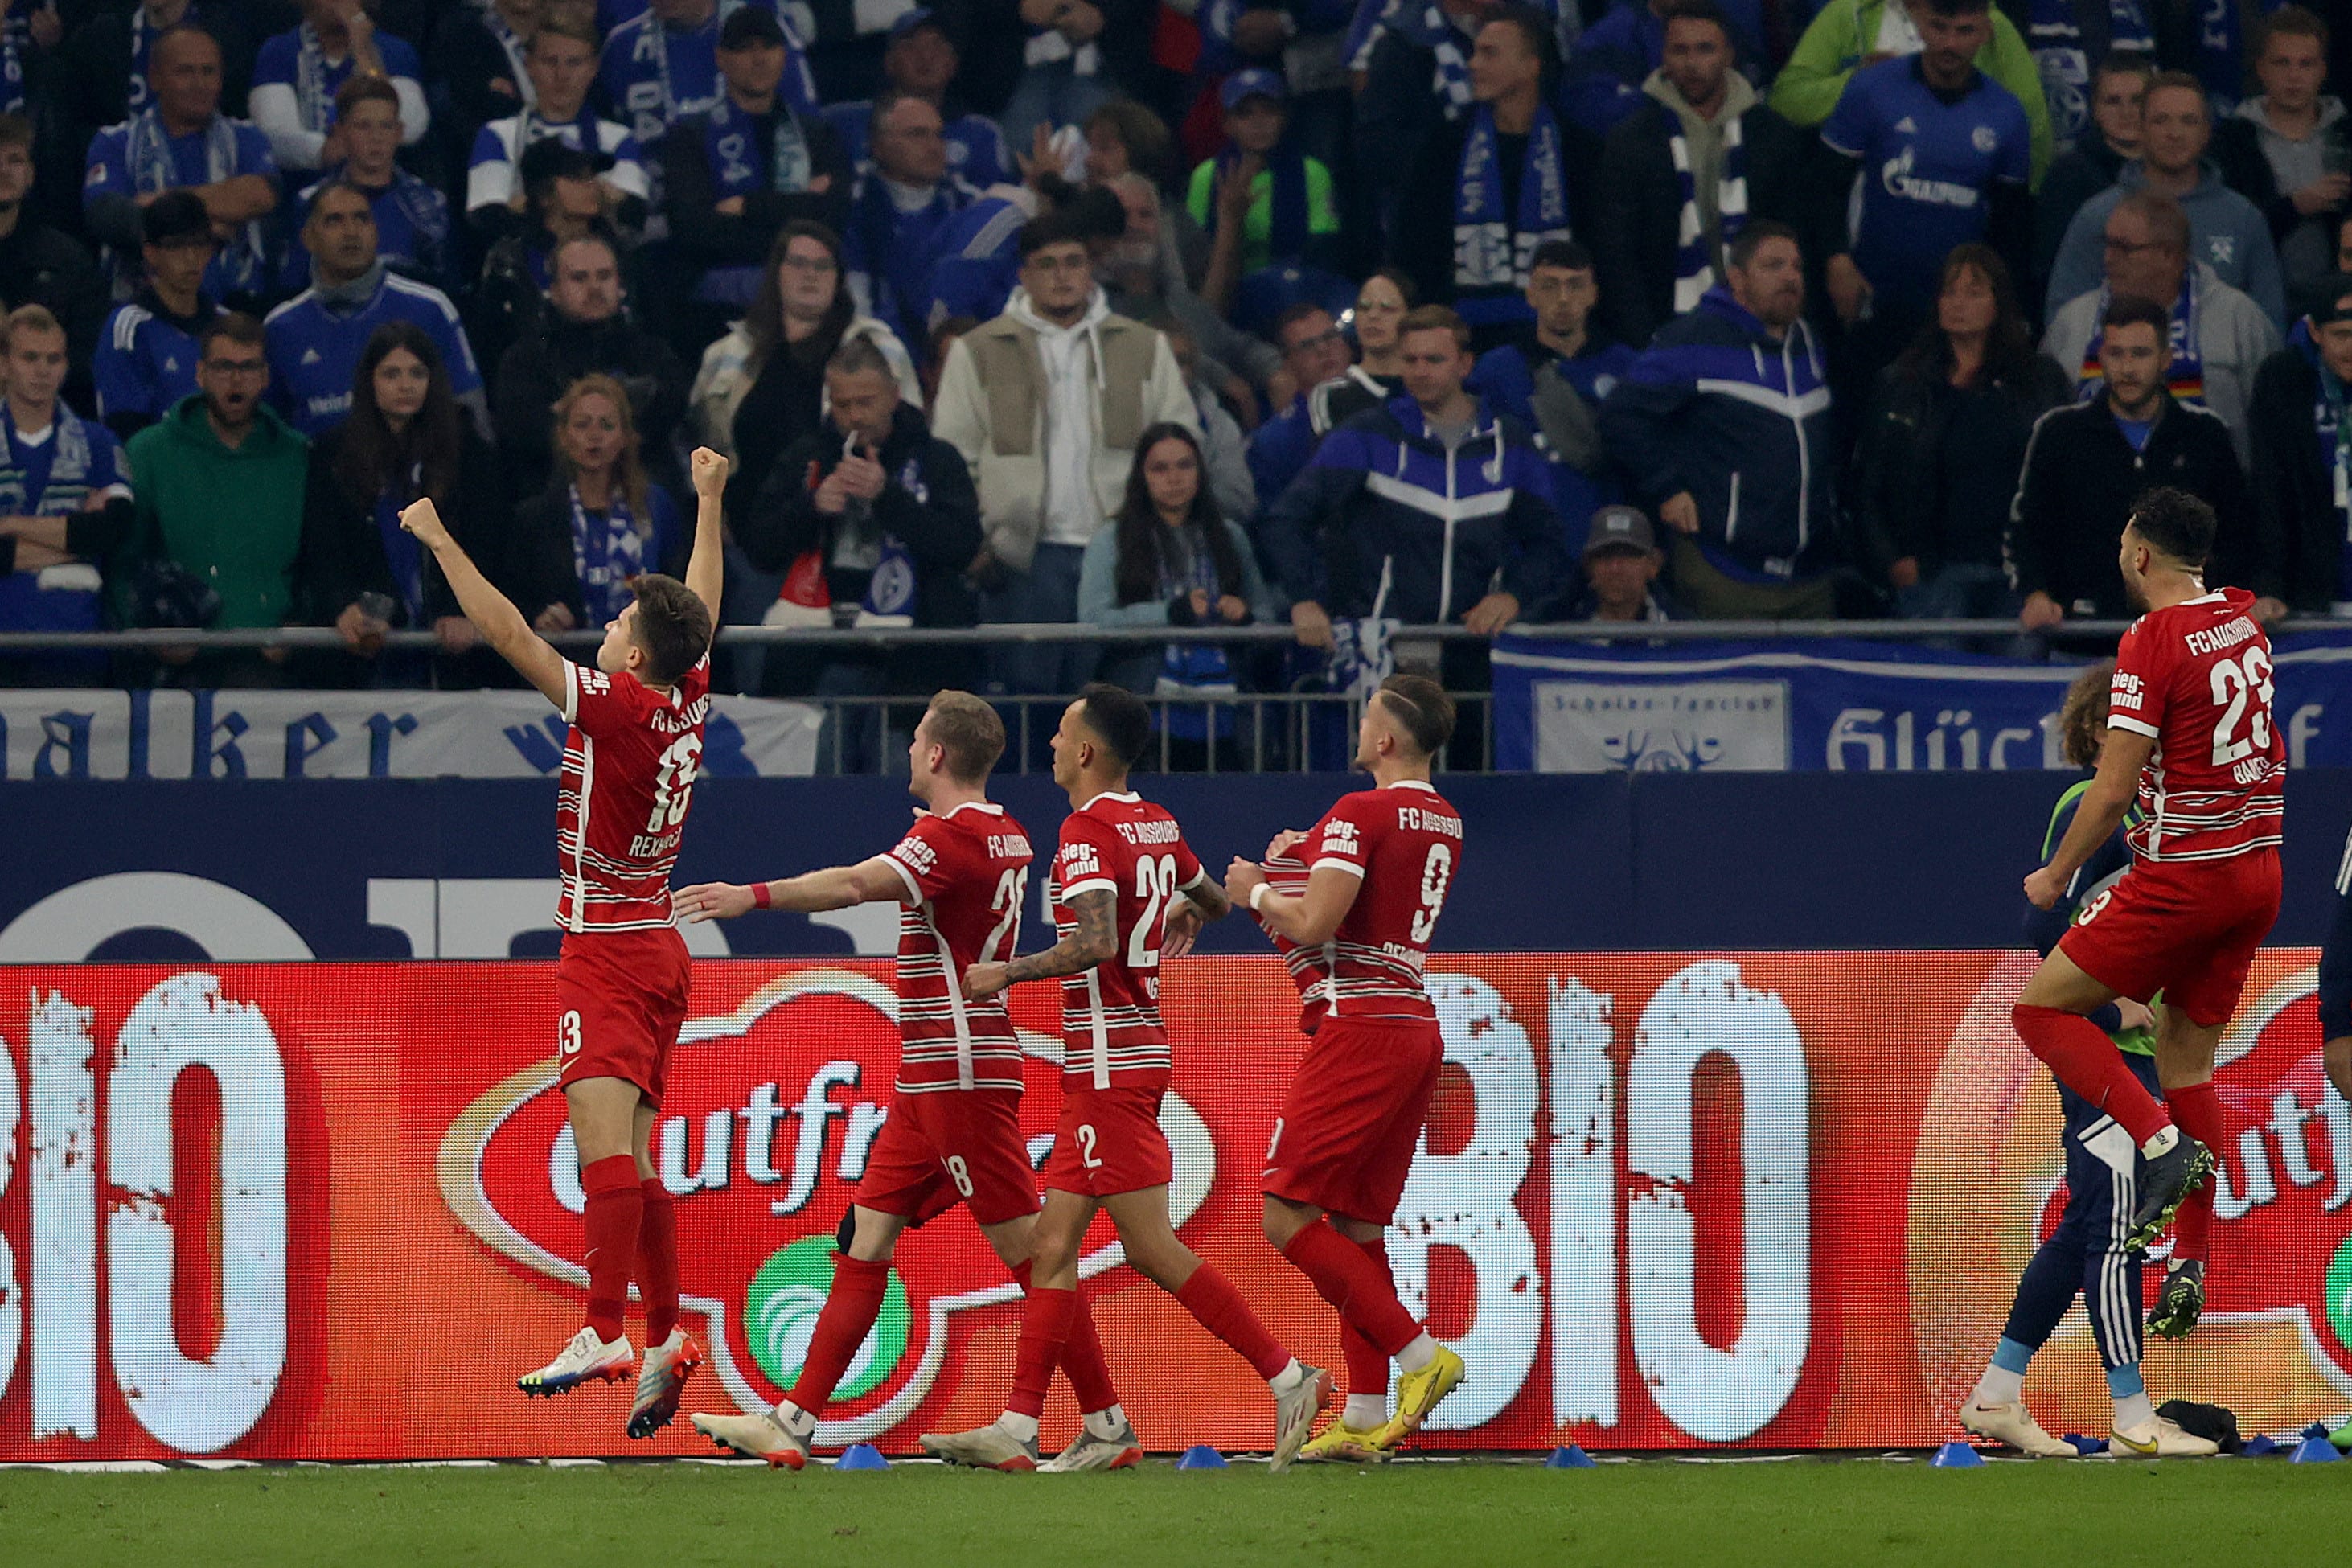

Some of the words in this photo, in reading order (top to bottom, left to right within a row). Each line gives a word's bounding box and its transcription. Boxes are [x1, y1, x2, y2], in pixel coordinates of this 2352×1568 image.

[2185, 630, 2211, 656] FC
[2208, 615, 2259, 651] AUGSBUR
[2210, 646, 2275, 766] 23
[0, 688, 419, 780] alker
[1323, 817, 1361, 839] sieg-
[1398, 807, 1420, 831] FC
[987, 835, 1004, 859] FC
[1127, 853, 1177, 967] 22
[1410, 843, 1451, 944] 9
[2078, 889, 2112, 926] 3
[1074, 1124, 1102, 1168] 2
[941, 1155, 974, 1197] 8
[1385, 959, 1811, 1443] BIO
